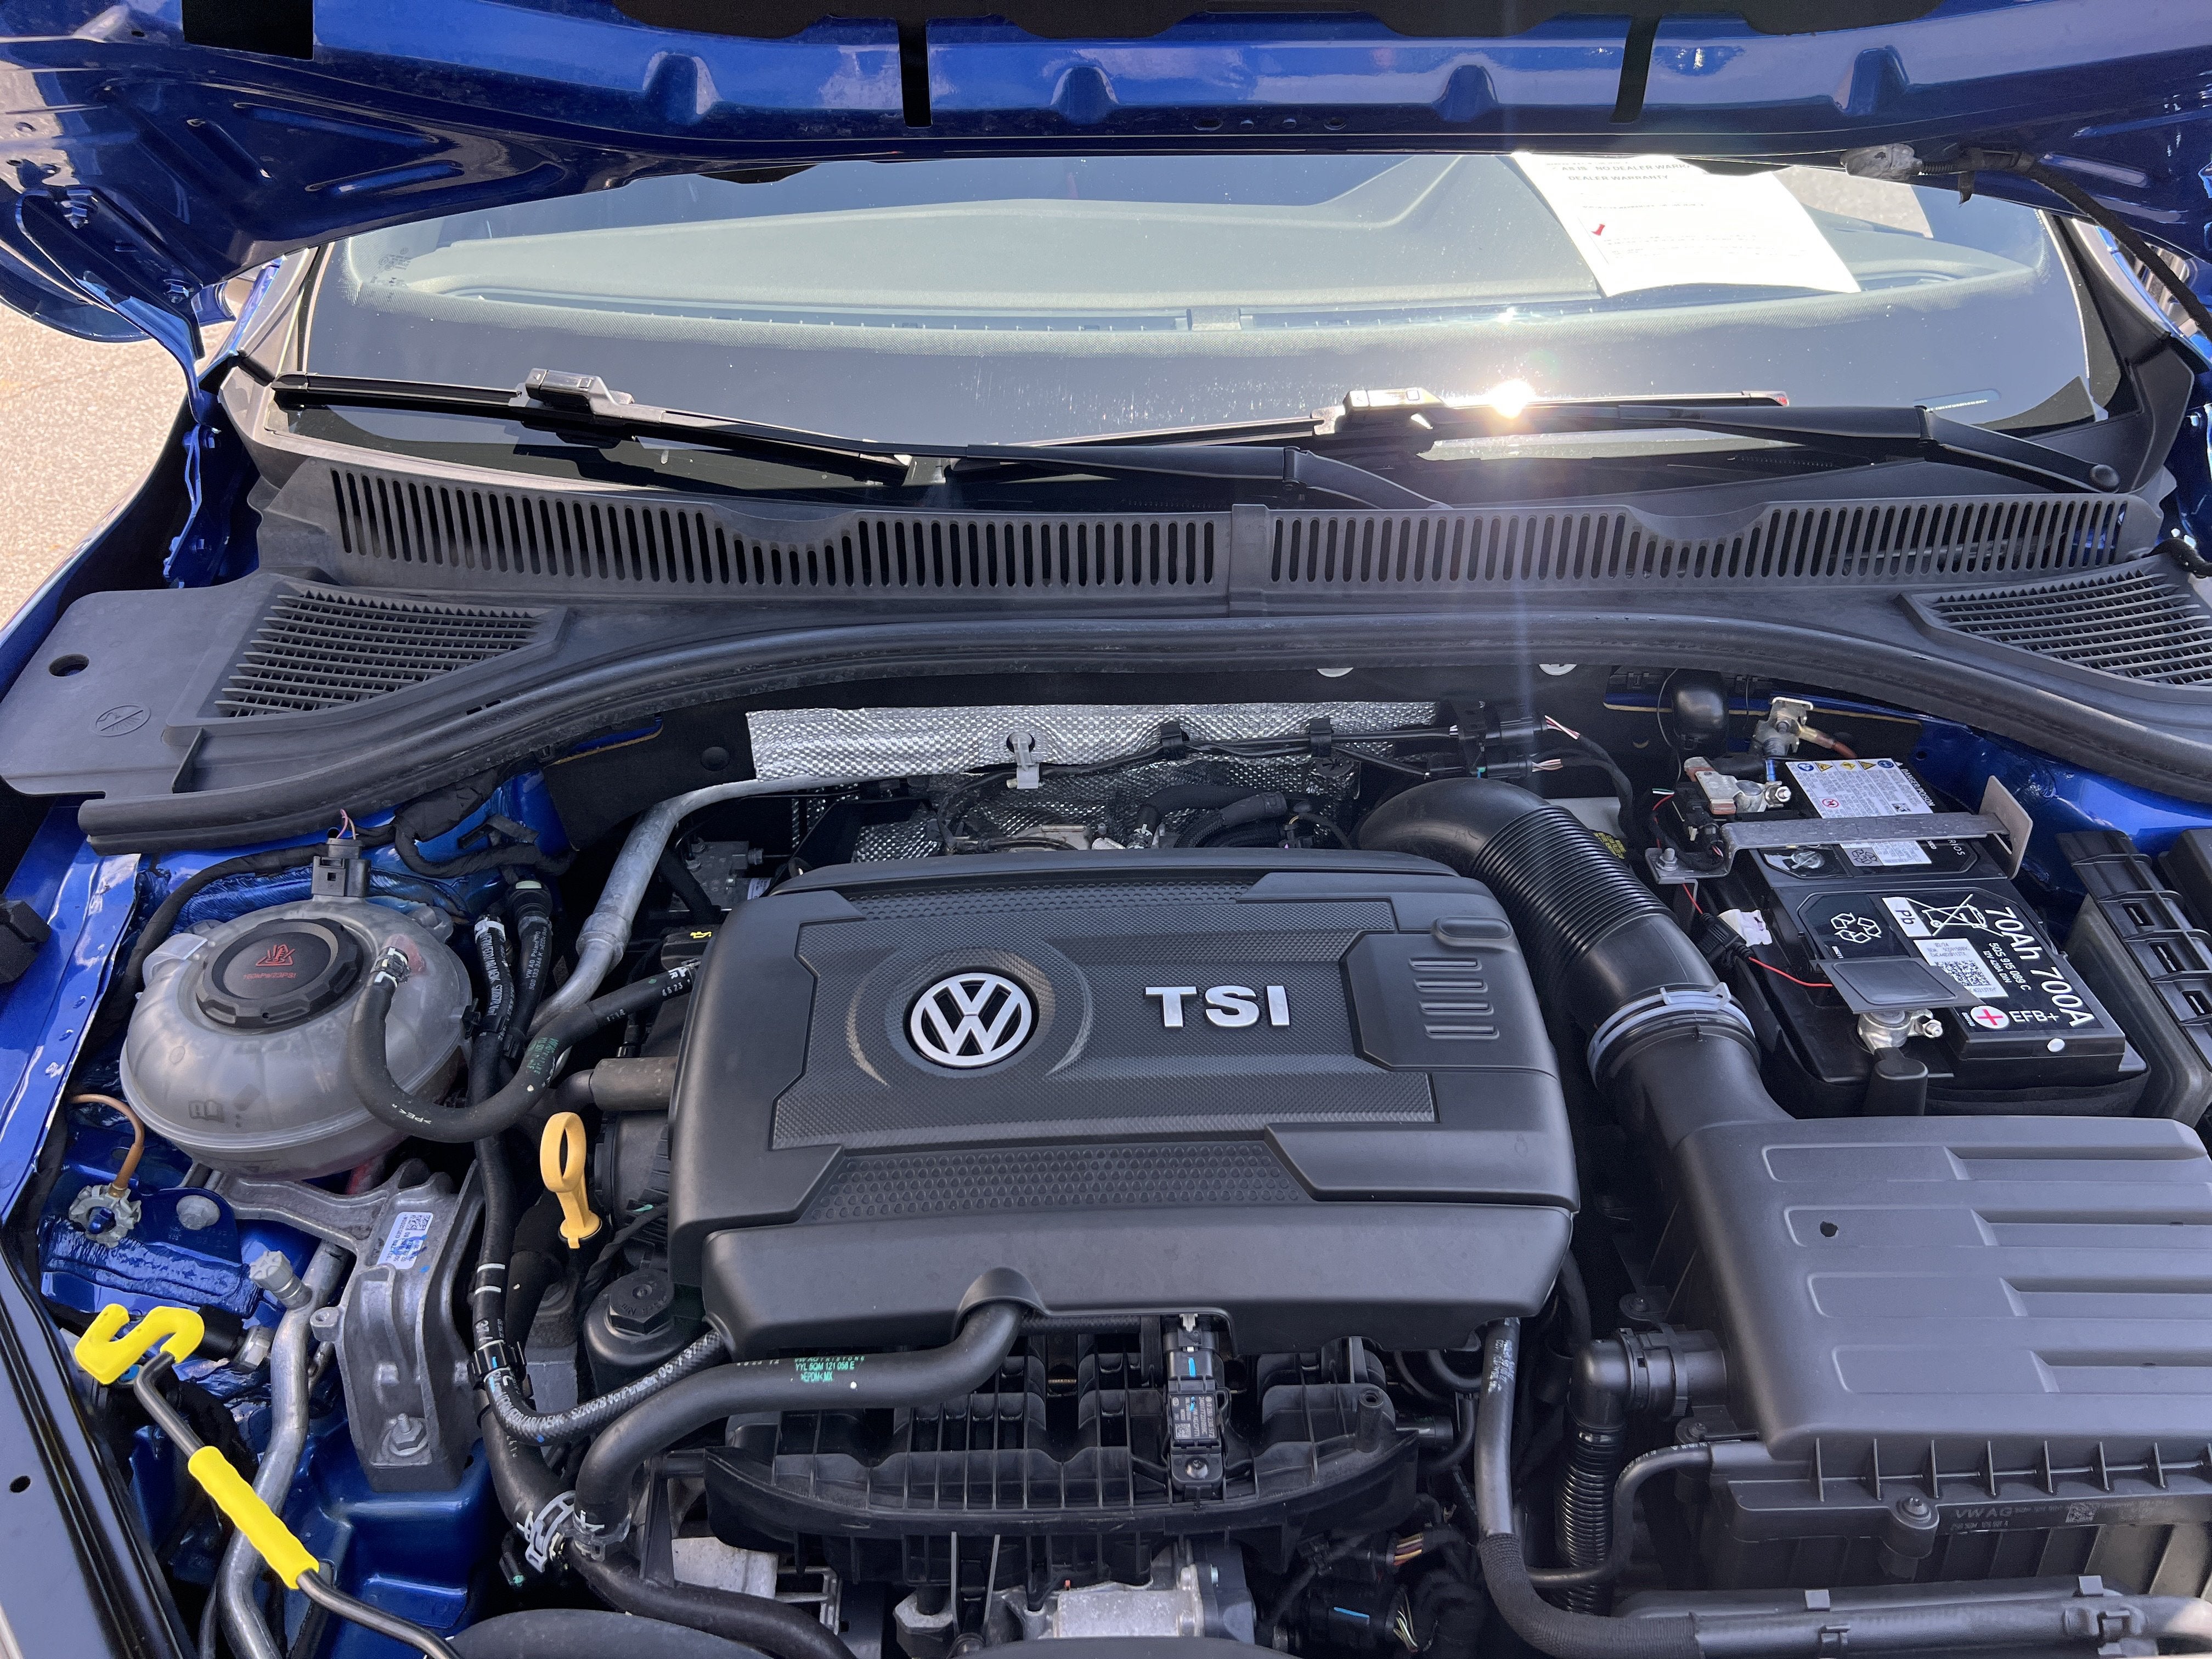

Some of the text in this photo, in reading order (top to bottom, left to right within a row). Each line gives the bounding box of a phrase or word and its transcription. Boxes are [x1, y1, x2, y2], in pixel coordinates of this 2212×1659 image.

[1895, 910, 1915, 924] Pb
[1983, 950, 1995, 961] 12V
[1999, 973, 2012, 983] DIN
[1985, 906, 2095, 1028] 70Ah 700A
[2000, 957, 2016, 970] 915
[2009, 970, 2026, 984] 089
[910, 972, 1033, 1068] VW
[1144, 985, 1291, 1028] TSI
[2008, 1010, 2059, 1023] EFB+
[826, 1362, 836, 1370] 121
[850, 1361, 855, 1370] E
